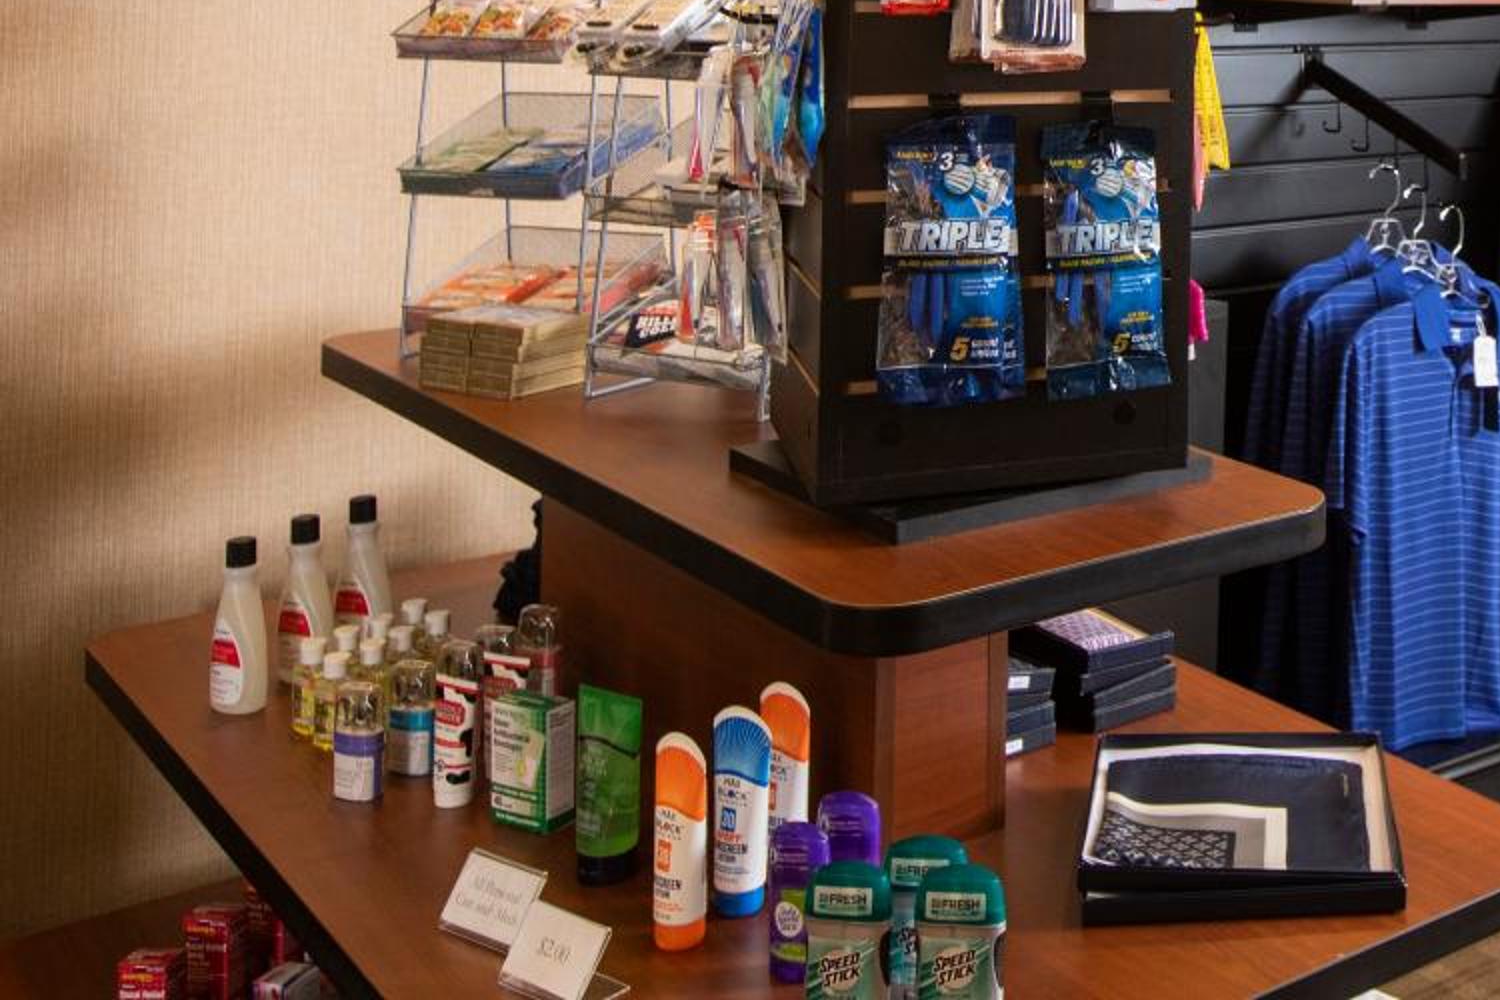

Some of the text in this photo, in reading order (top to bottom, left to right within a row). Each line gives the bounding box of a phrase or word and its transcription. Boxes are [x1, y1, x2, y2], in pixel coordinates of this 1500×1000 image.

[938, 151, 954, 171] 3
[820, 951, 861, 973] SPEED
[933, 949, 976, 973] SPEED
[823, 967, 859, 988] STICK
[937, 963, 975, 986] STICK
